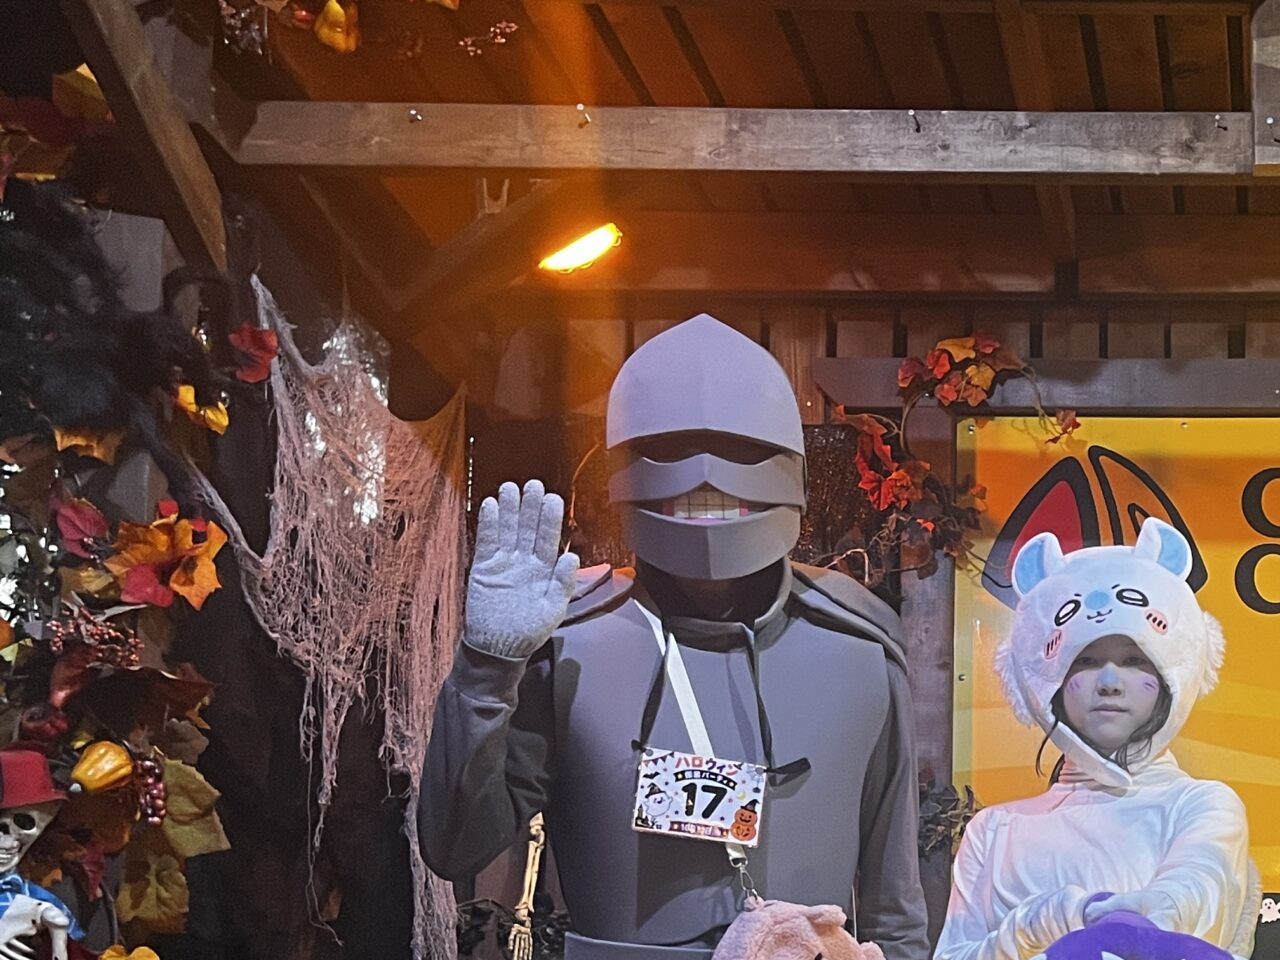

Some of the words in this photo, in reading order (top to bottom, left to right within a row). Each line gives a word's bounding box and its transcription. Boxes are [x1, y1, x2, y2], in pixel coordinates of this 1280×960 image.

[675, 756, 739, 776] ハロウィン
[682, 783, 727, 819] 17
